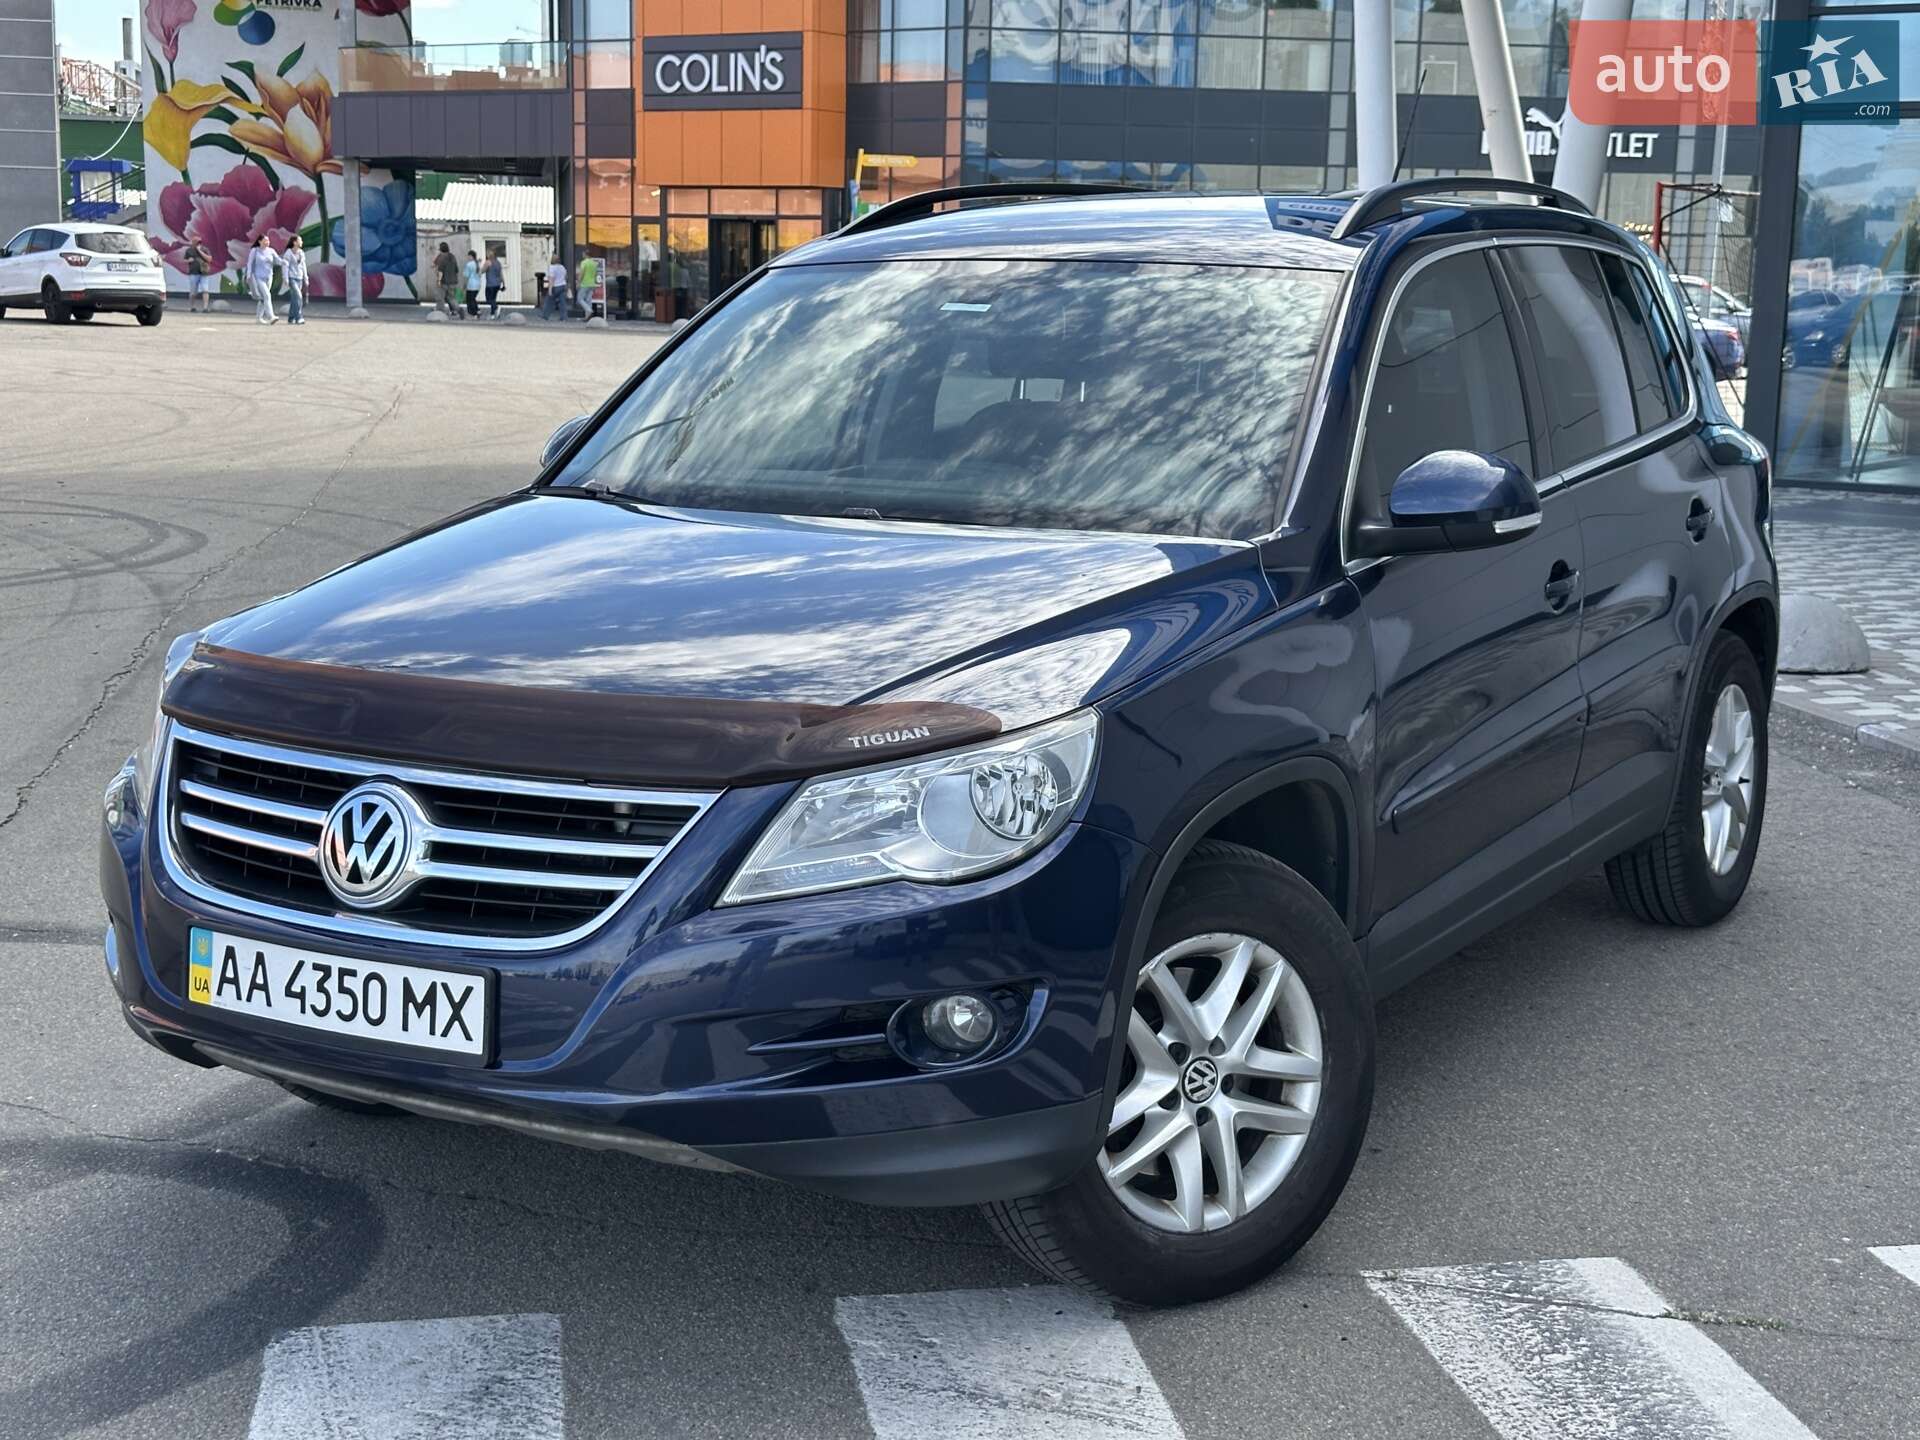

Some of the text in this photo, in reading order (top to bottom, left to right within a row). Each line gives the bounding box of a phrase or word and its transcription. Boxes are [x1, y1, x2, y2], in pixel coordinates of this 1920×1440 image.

[655, 44, 785, 93] COLIN'S
[848, 726, 930, 748] TIGUAN
[194, 975, 210, 994] UA
[216, 945, 475, 1042] AA 4350 MX
